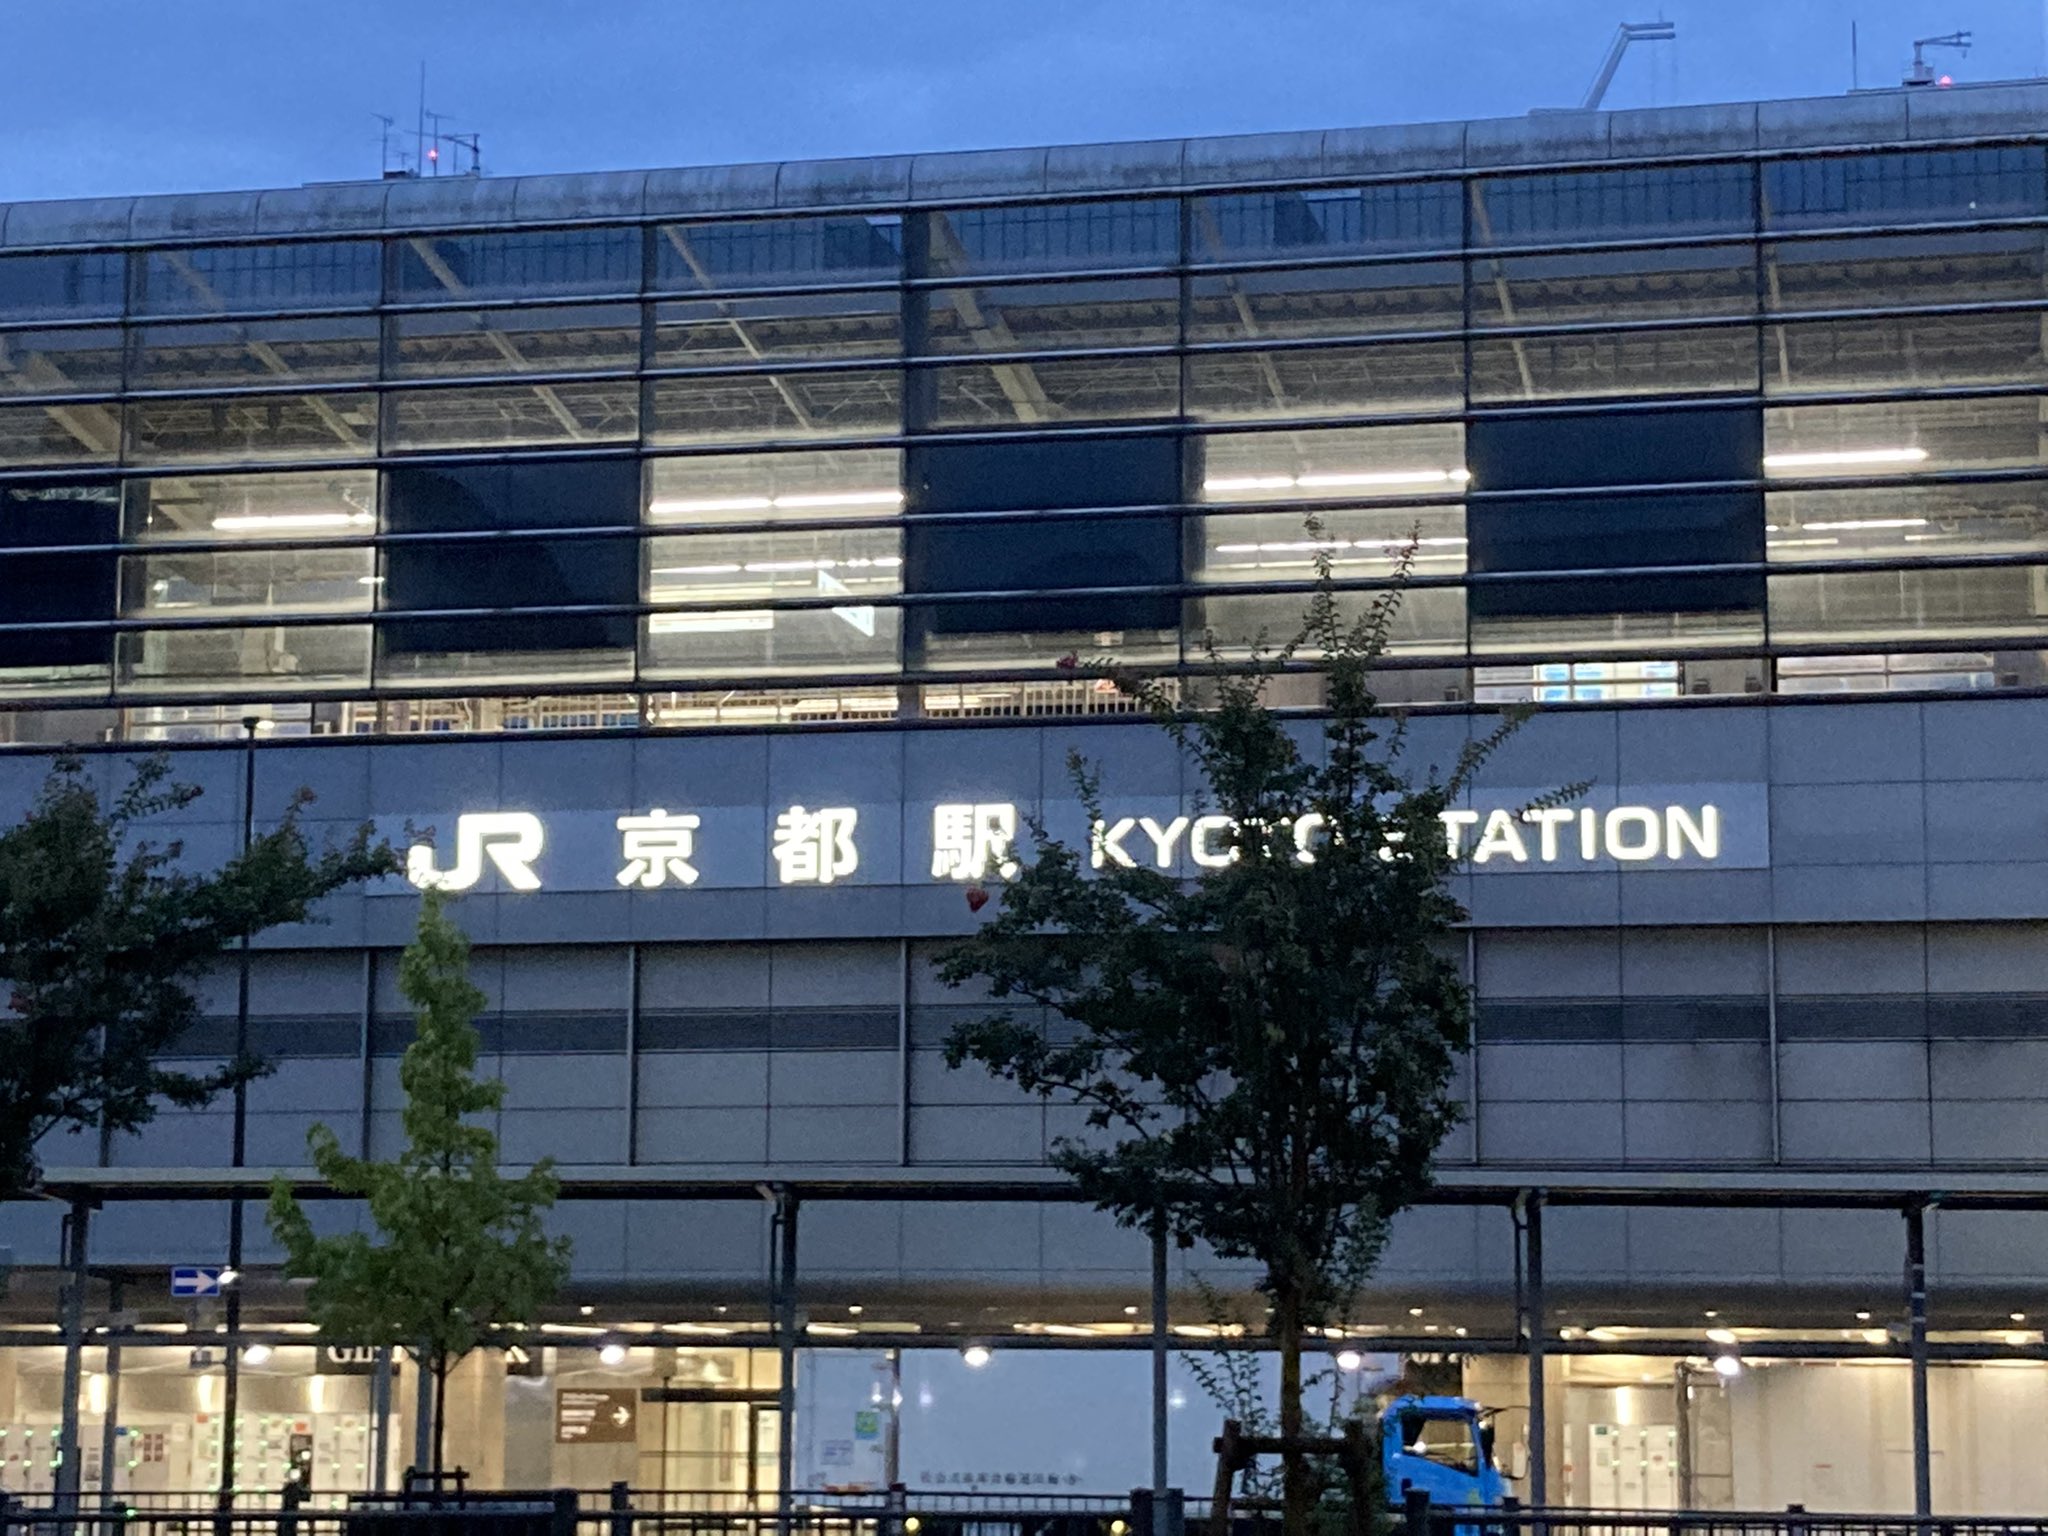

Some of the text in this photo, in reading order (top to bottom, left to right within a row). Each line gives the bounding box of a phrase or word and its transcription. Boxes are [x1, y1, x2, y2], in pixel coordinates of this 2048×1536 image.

[407, 812, 545, 891] JR
[614, 803, 1020, 889] 京都駅
